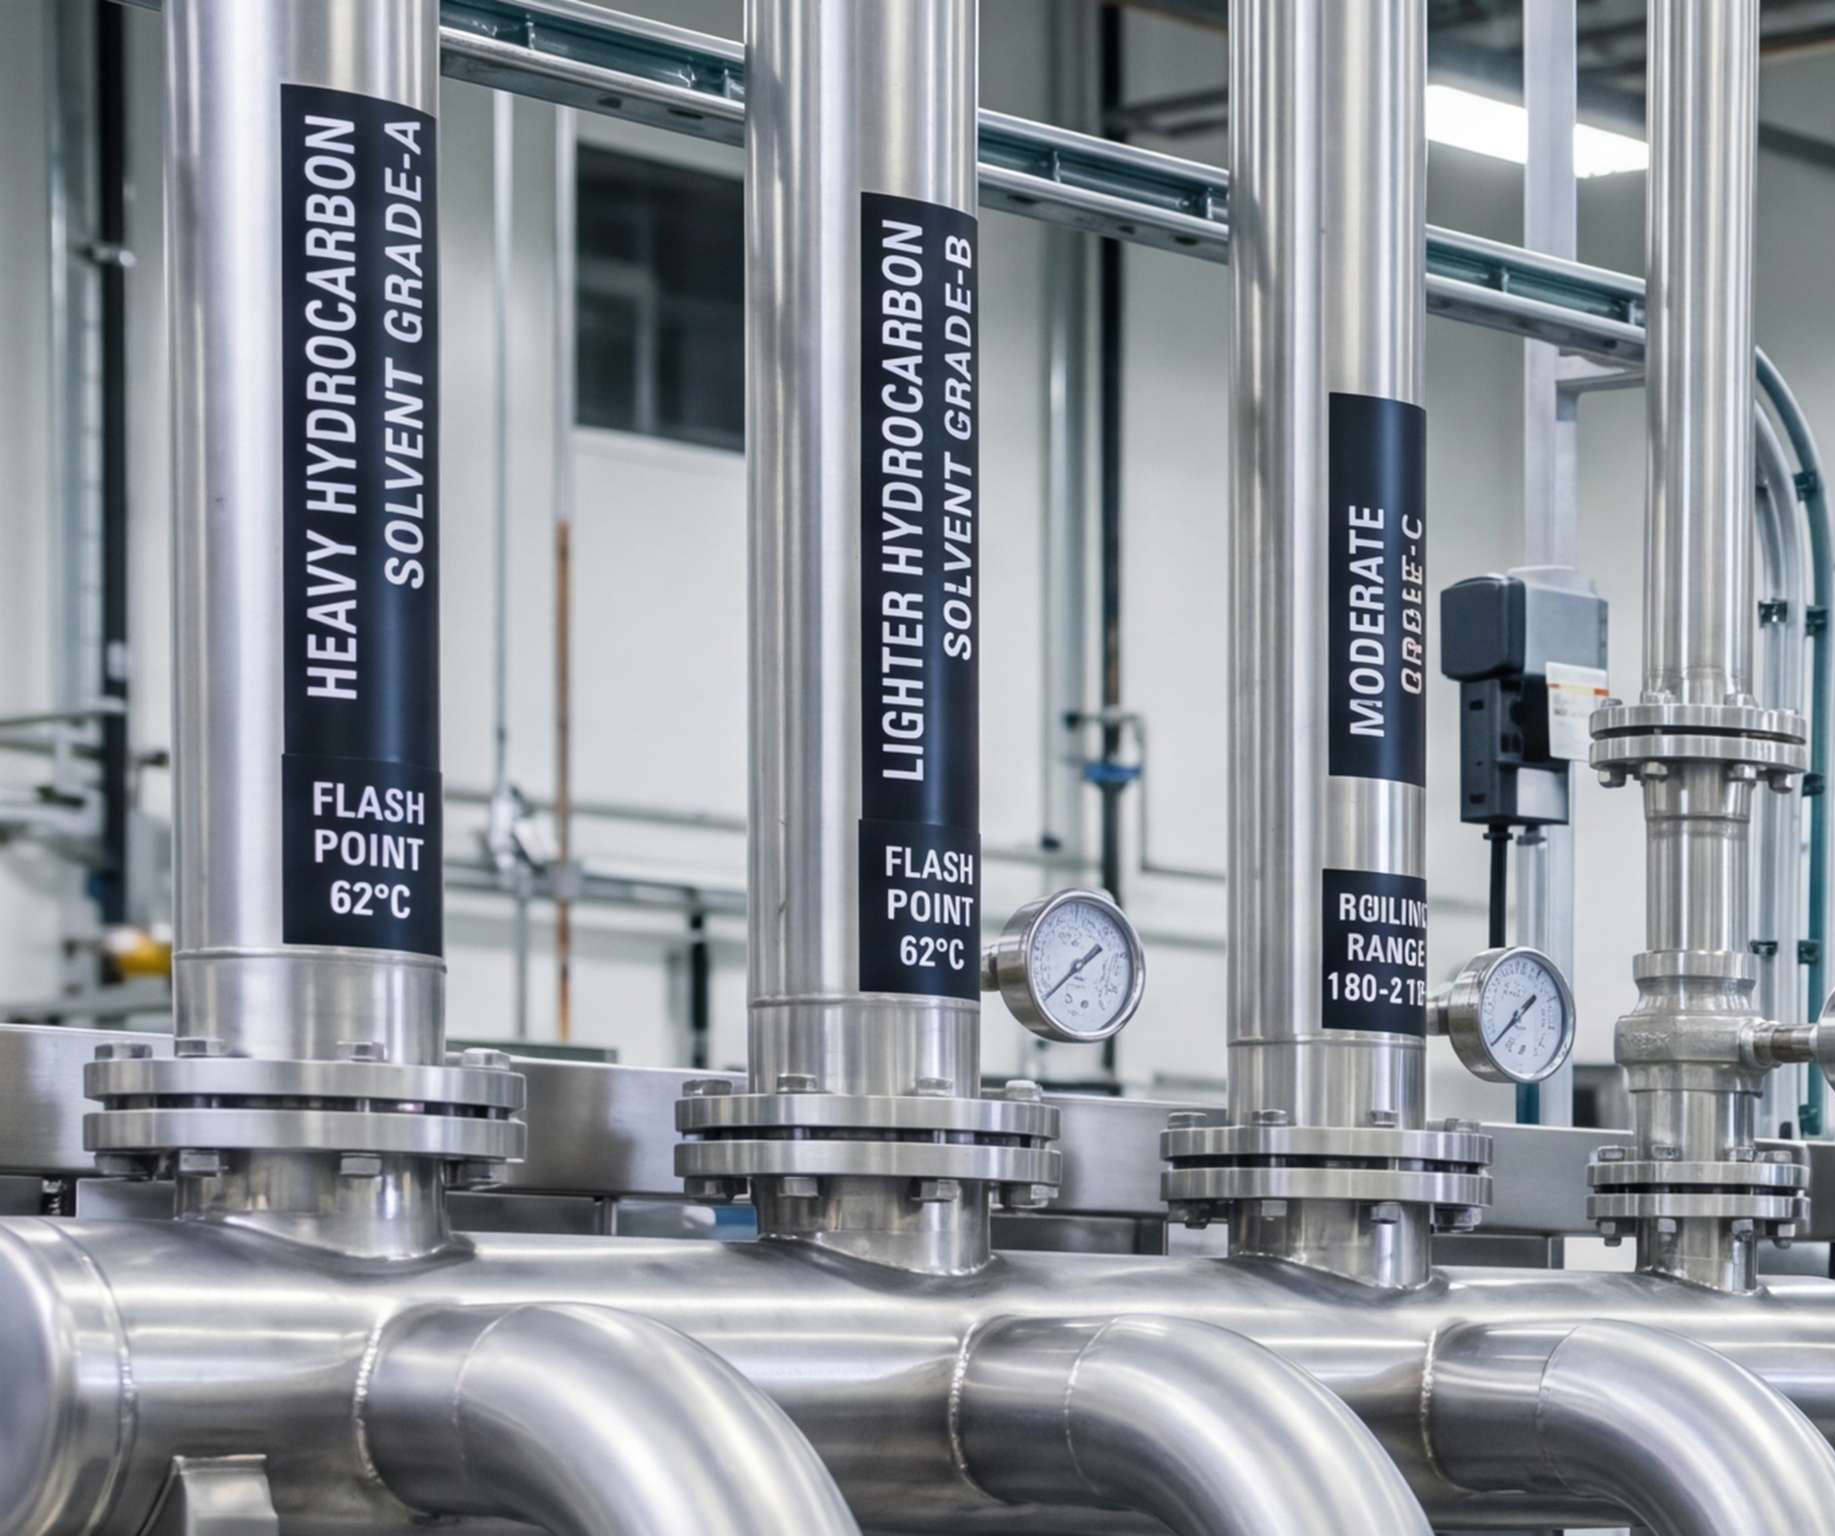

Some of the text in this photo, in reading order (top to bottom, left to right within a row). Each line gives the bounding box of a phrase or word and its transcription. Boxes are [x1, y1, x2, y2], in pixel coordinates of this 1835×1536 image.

[384, 120, 425, 590] SOLVENT GRADE-A
[305, 116, 358, 699] HEAVY HYDROCARBON
[943, 235, 973, 660] SOLVENT GRADE-B
[882, 220, 924, 781] LIGHTER HYDROCARBON
[1349, 505, 1385, 737] MODERATE
[313, 781, 424, 825] FLASH
[315, 829, 424, 871] POINT
[885, 845, 973, 885] FLASH
[330, 880, 411, 919] 62°C
[887, 889, 973, 926] POINT
[900, 935, 964, 970] 62°C
[1348, 933, 1425, 967] RANGE
